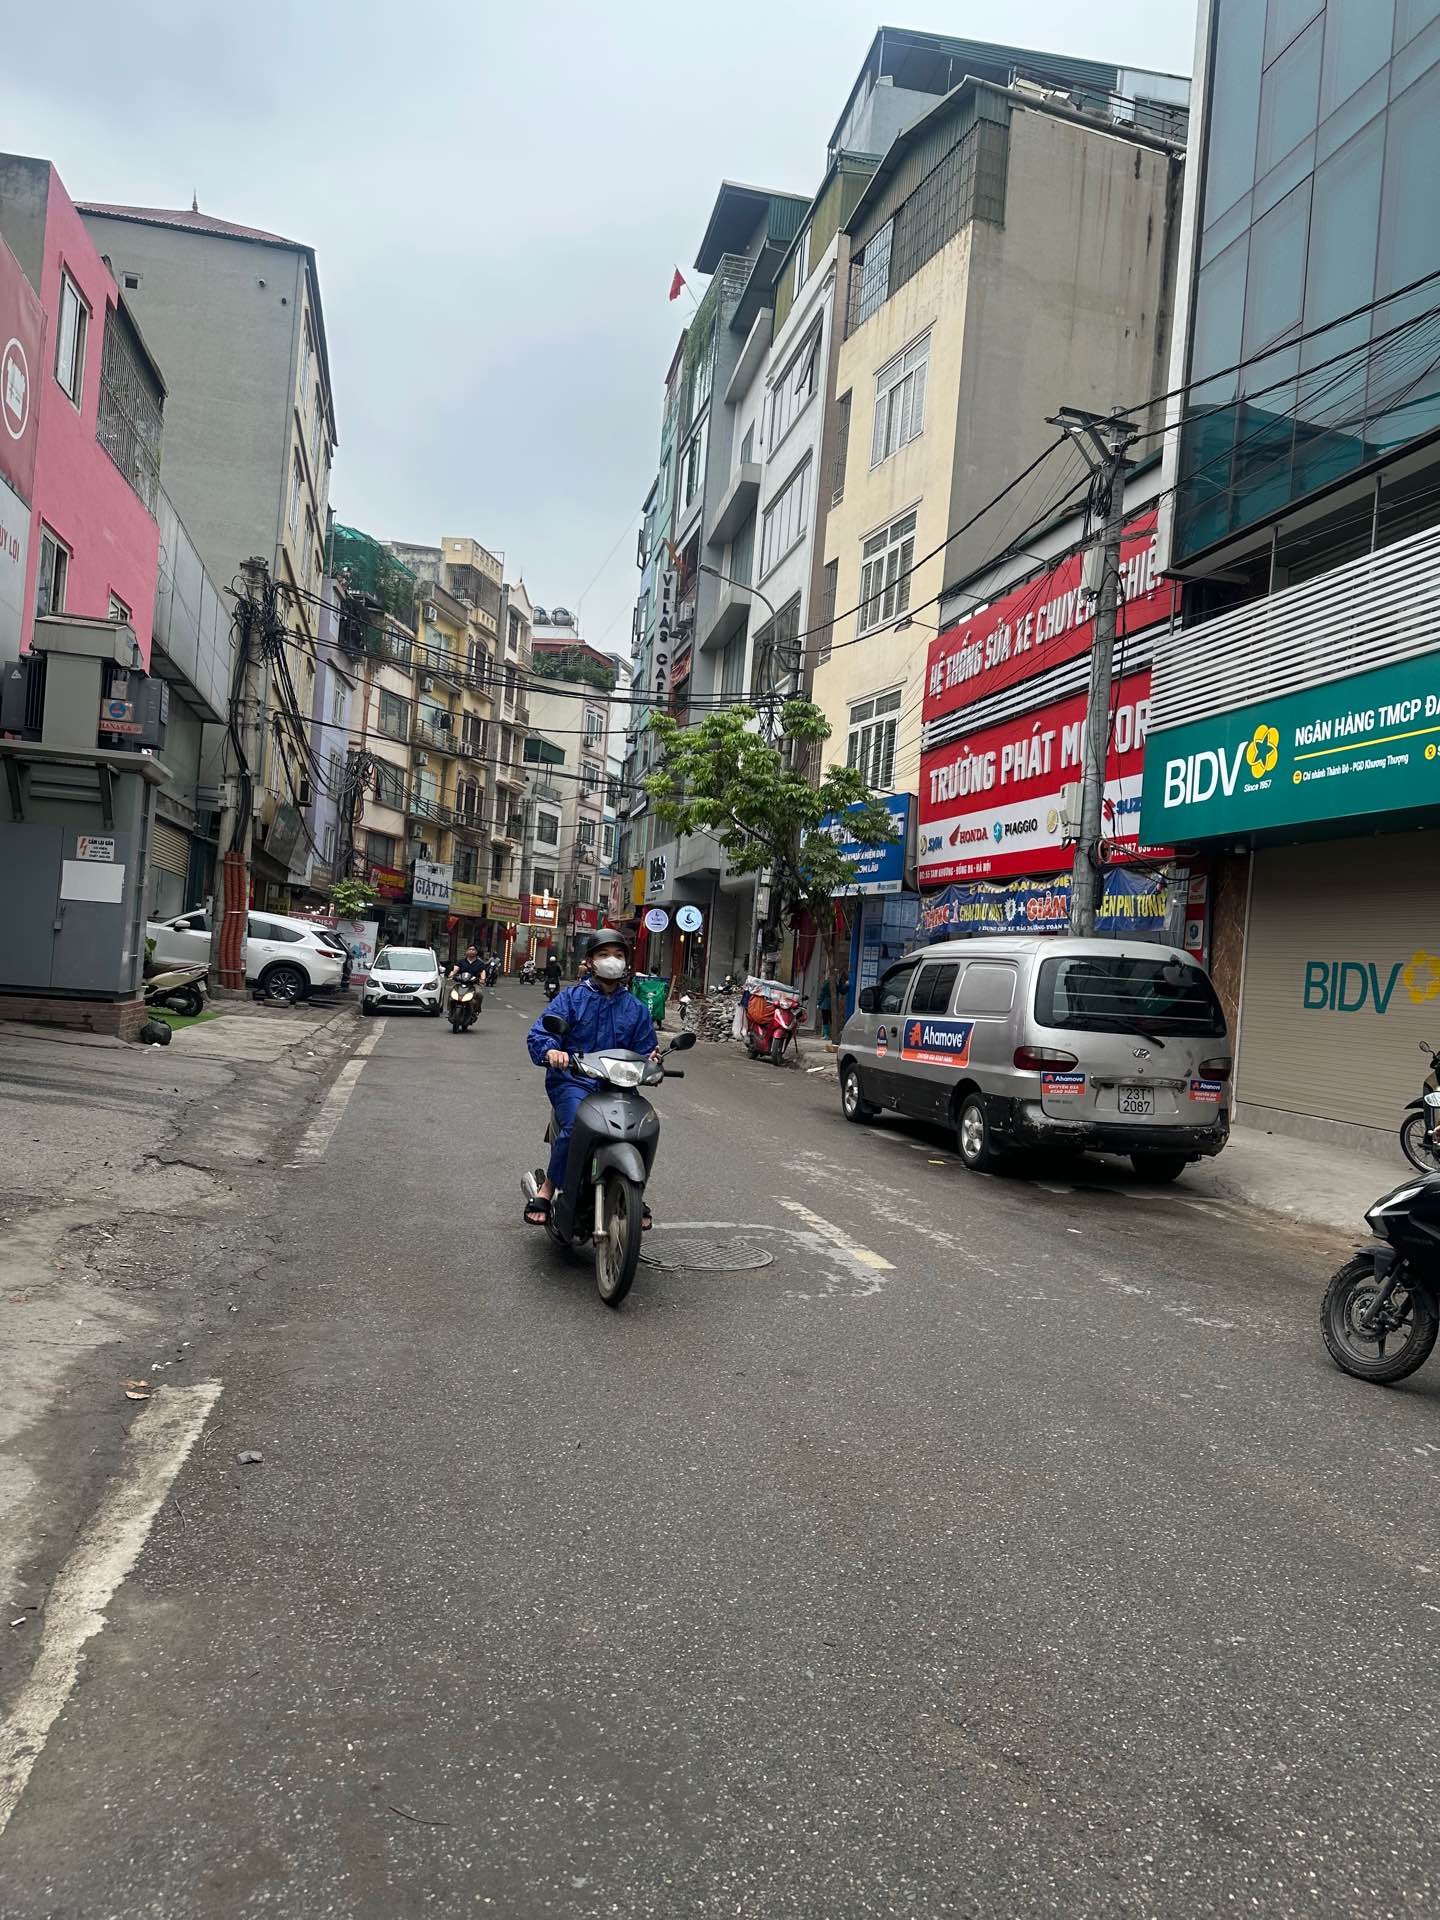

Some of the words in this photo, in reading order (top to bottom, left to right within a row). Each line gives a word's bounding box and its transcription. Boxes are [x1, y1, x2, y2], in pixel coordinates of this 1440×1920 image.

[658, 574, 673, 643] VELAS
[984, 617, 1012, 670] SỬA
[1015, 612, 1034, 657] XE
[1295, 719, 1332, 747] NGÂN
[1334, 711, 1375, 738] HÀNG
[1378, 699, 1422, 727] TMCP
[929, 745, 997, 804] TRƯỜNG
[1001, 721, 1056, 785] PHÁT
[1061, 699, 1150, 769] MOR
[1163, 740, 1249, 808] BIDV
[1243, 782, 1259, 793] Since
[960, 827, 989, 844] HONDA
[1004, 818, 1038, 837] PIAGGIO
[1026, 890, 1068, 921] GIẢM
[1304, 960, 1404, 1014] BIDV
[922, 1025, 963, 1048] Ahamove
[1055, 1075, 1084, 1083] Ahamove
[1123, 1100, 1151, 1113] 2087
